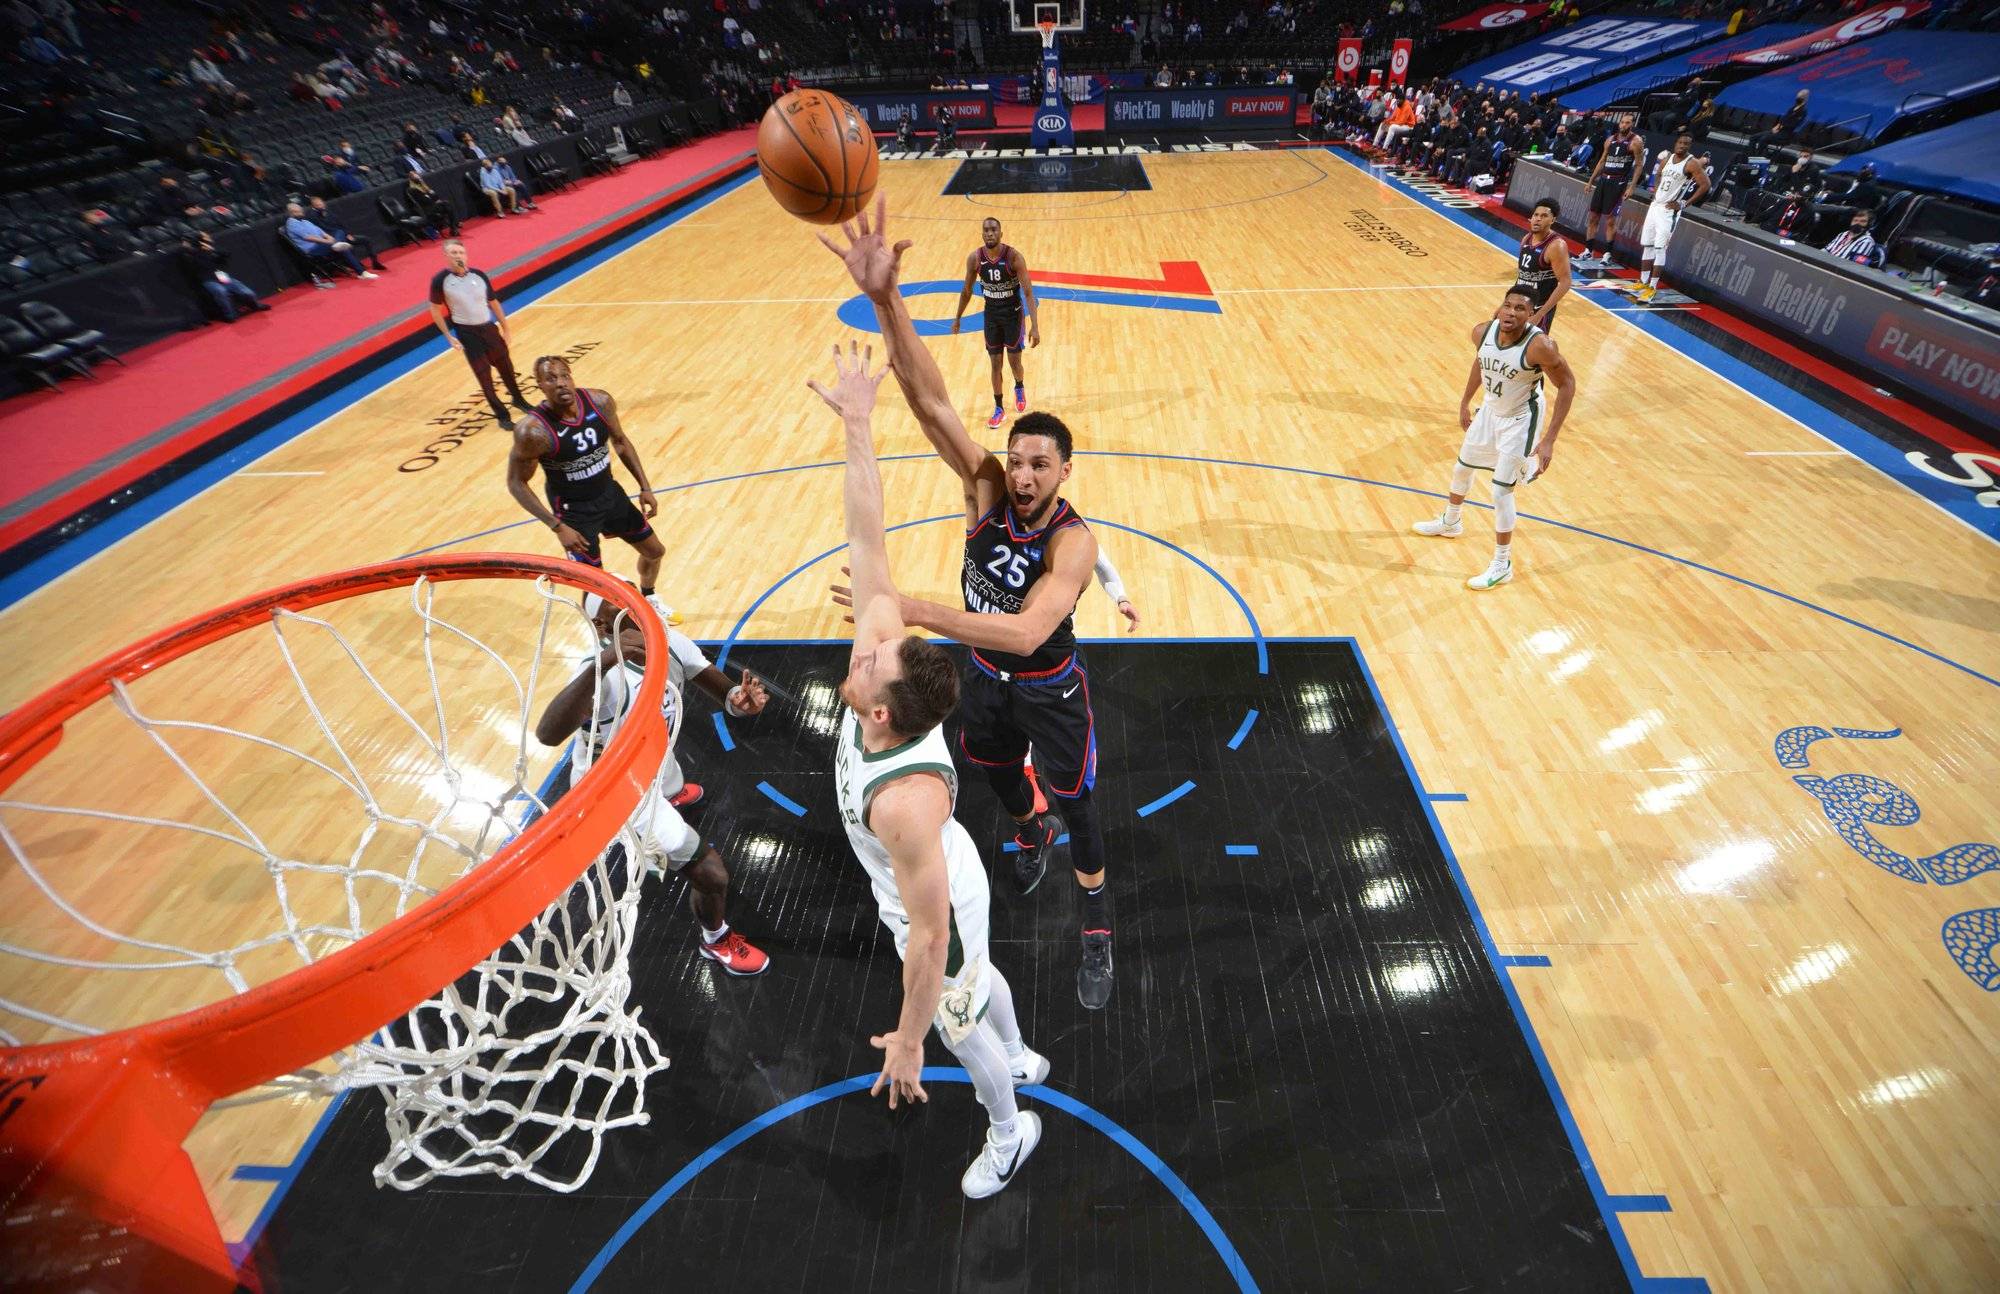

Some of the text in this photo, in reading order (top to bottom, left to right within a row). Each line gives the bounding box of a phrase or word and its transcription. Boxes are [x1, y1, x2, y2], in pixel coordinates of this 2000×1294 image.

[911, 103, 918, 120] 6
[932, 105, 957, 115] PAY
[958, 104, 981, 115] NOW
[1122, 99, 1285, 121] Pick'Em Weekly 6 PLAY NOW
[1042, 118, 1062, 129] KIA
[878, 143, 1262, 160] HILADELPHIA, USA
[1521, 253, 1532, 268] 12
[988, 268, 1001, 281] 18
[1762, 269, 1828, 335] Weekly
[1822, 294, 1846, 336] 6
[1478, 357, 1519, 380] BUCKS
[1880, 326, 2000, 399] PLAY NOW
[1485, 375, 1503, 398] 34
[572, 427, 598, 451] 39
[987, 544, 1030, 588] 25
[837, 736, 860, 825] UCKS
